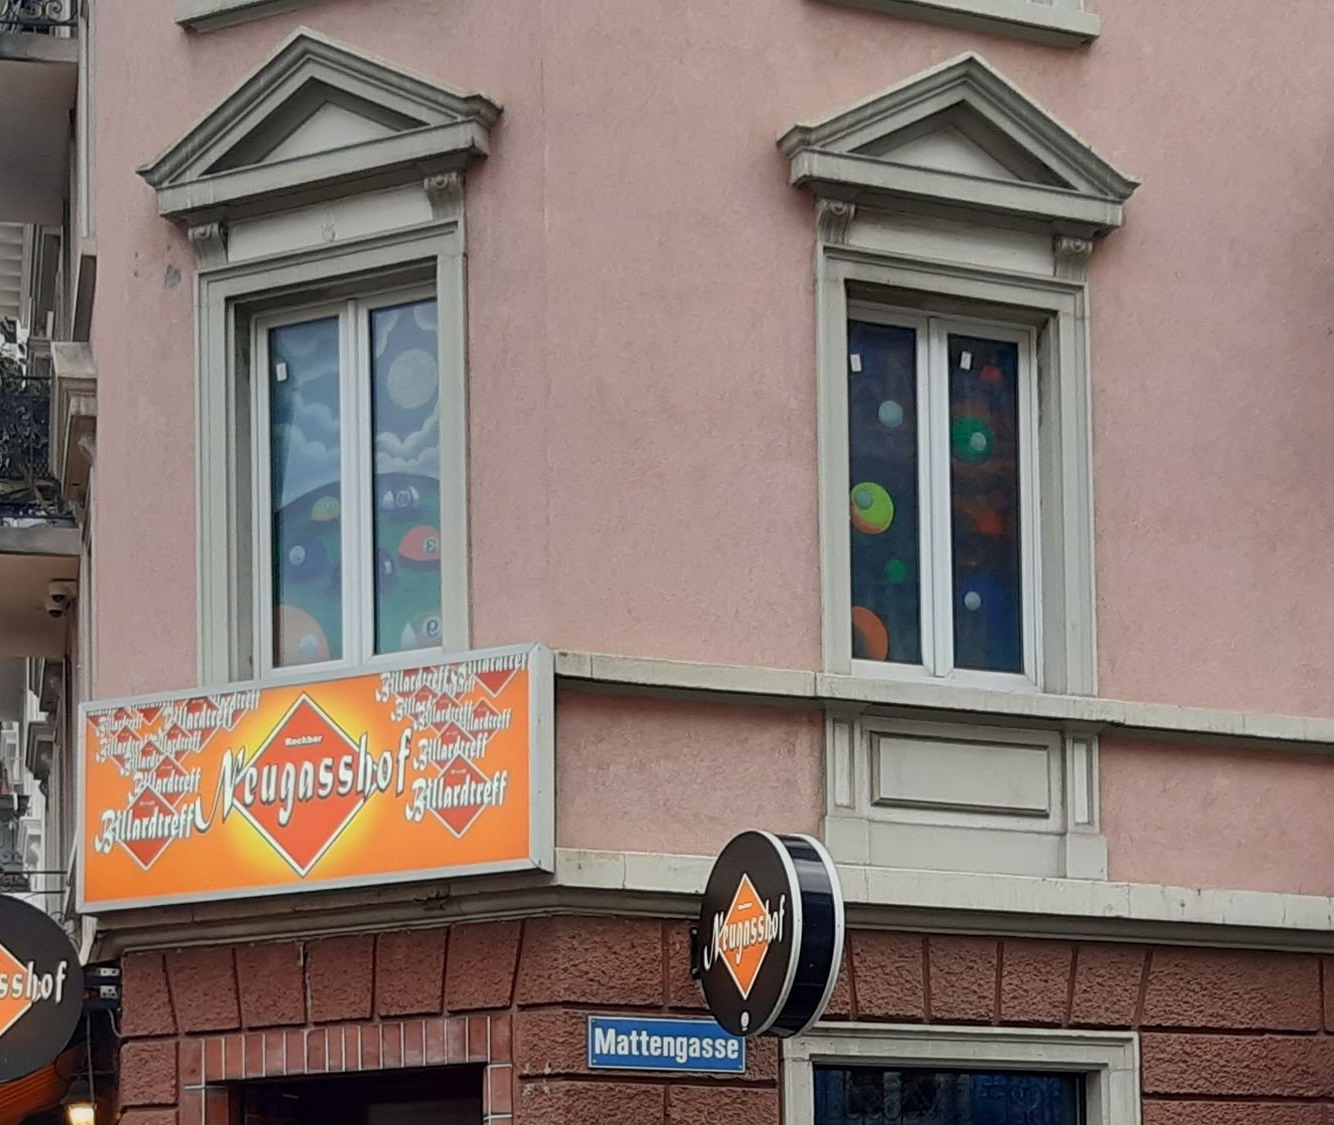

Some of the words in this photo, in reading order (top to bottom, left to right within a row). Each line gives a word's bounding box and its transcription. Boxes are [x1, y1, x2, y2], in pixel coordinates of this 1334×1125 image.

[194, 728, 412, 830] Neugasshof
[405, 770, 508, 822] Billardtreff
[94, 803, 195, 854] Billardtreff
[703, 895, 786, 972] Neugasshof
[594, 1028, 739, 1063] Mattengasse
